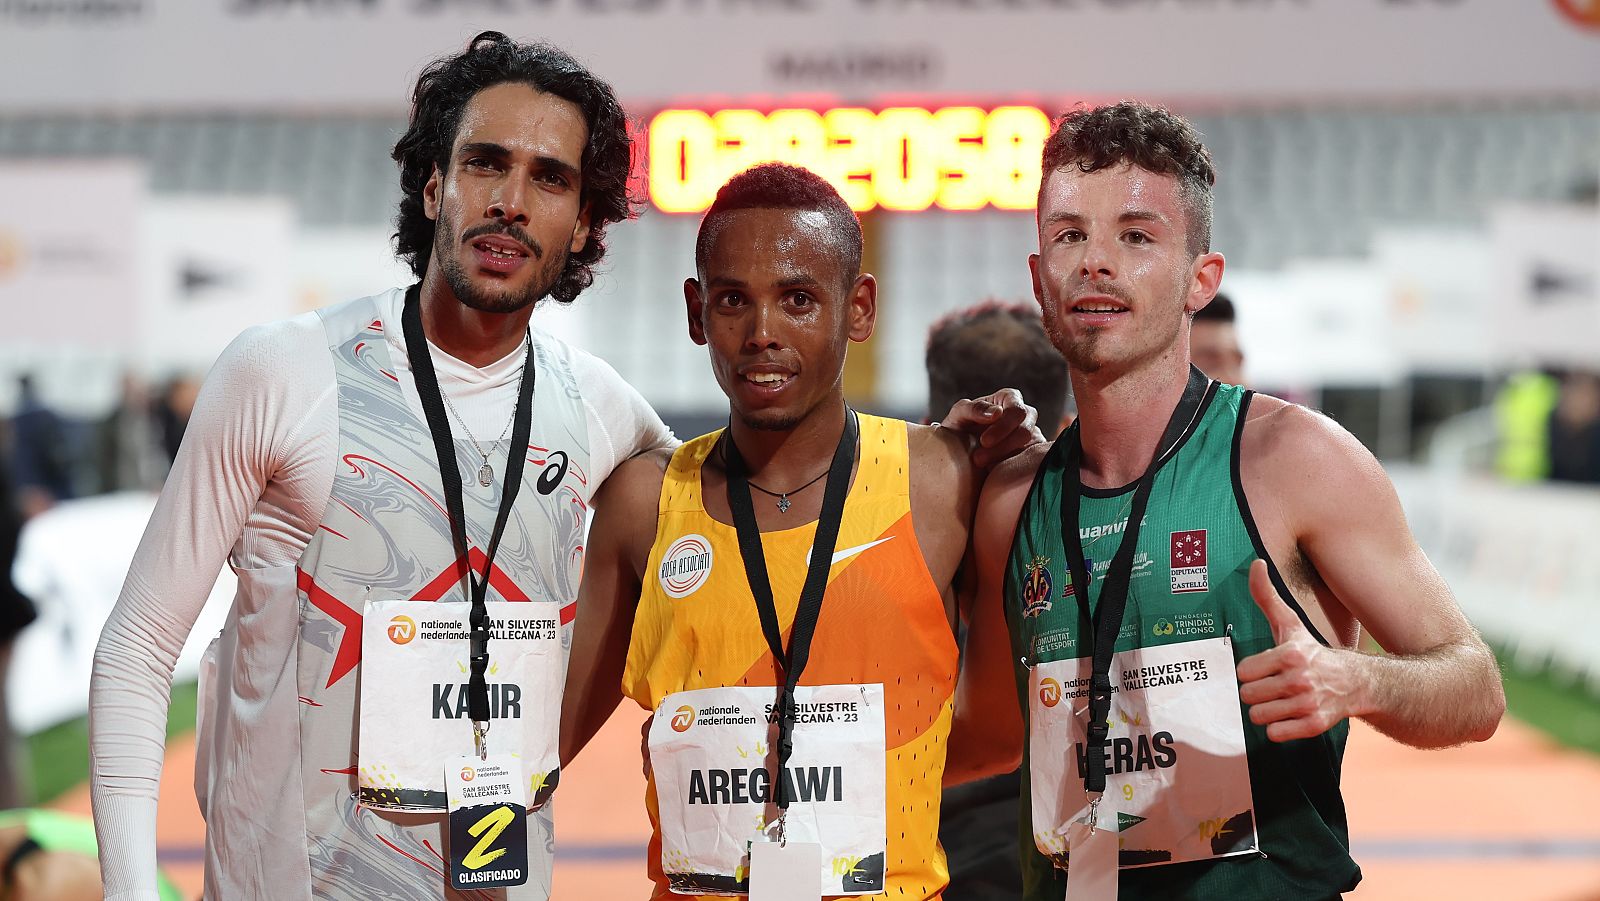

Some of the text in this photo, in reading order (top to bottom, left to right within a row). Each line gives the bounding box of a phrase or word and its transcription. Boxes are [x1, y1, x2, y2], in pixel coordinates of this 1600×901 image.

[1080, 517, 1129, 540] uanvi
[1171, 567, 1207, 576] DIPUTACIÓ
[1171, 581, 1208, 589] CASTELLÓ
[421, 619, 463, 630] nationale
[489, 619, 556, 630] AN SILVESTRE
[1174, 619, 1214, 628] TRINIDAD
[489, 630, 556, 641] ALLECANA 23
[1176, 626, 1215, 636] ALFONSO
[1122, 659, 1206, 682] SAN SILVESTRE
[1064, 677, 1092, 689] nation
[1124, 671, 1208, 692] VALLECANA 23
[1065, 685, 1119, 700] nederen
[432, 683, 521, 719] KAIR
[699, 704, 740, 716] nationale
[794, 702, 858, 713] SILVESTRE
[697, 715, 756, 726] nederlanden
[764, 713, 859, 725] VAECANA 23
[462, 783, 511, 794] SAN SILVESTRE
[1123, 784, 1133, 801] 9
[463, 790, 499, 799] VALLECANA
[832, 855, 867, 879] 10K
[459, 868, 521, 884] CLASIFICADO
